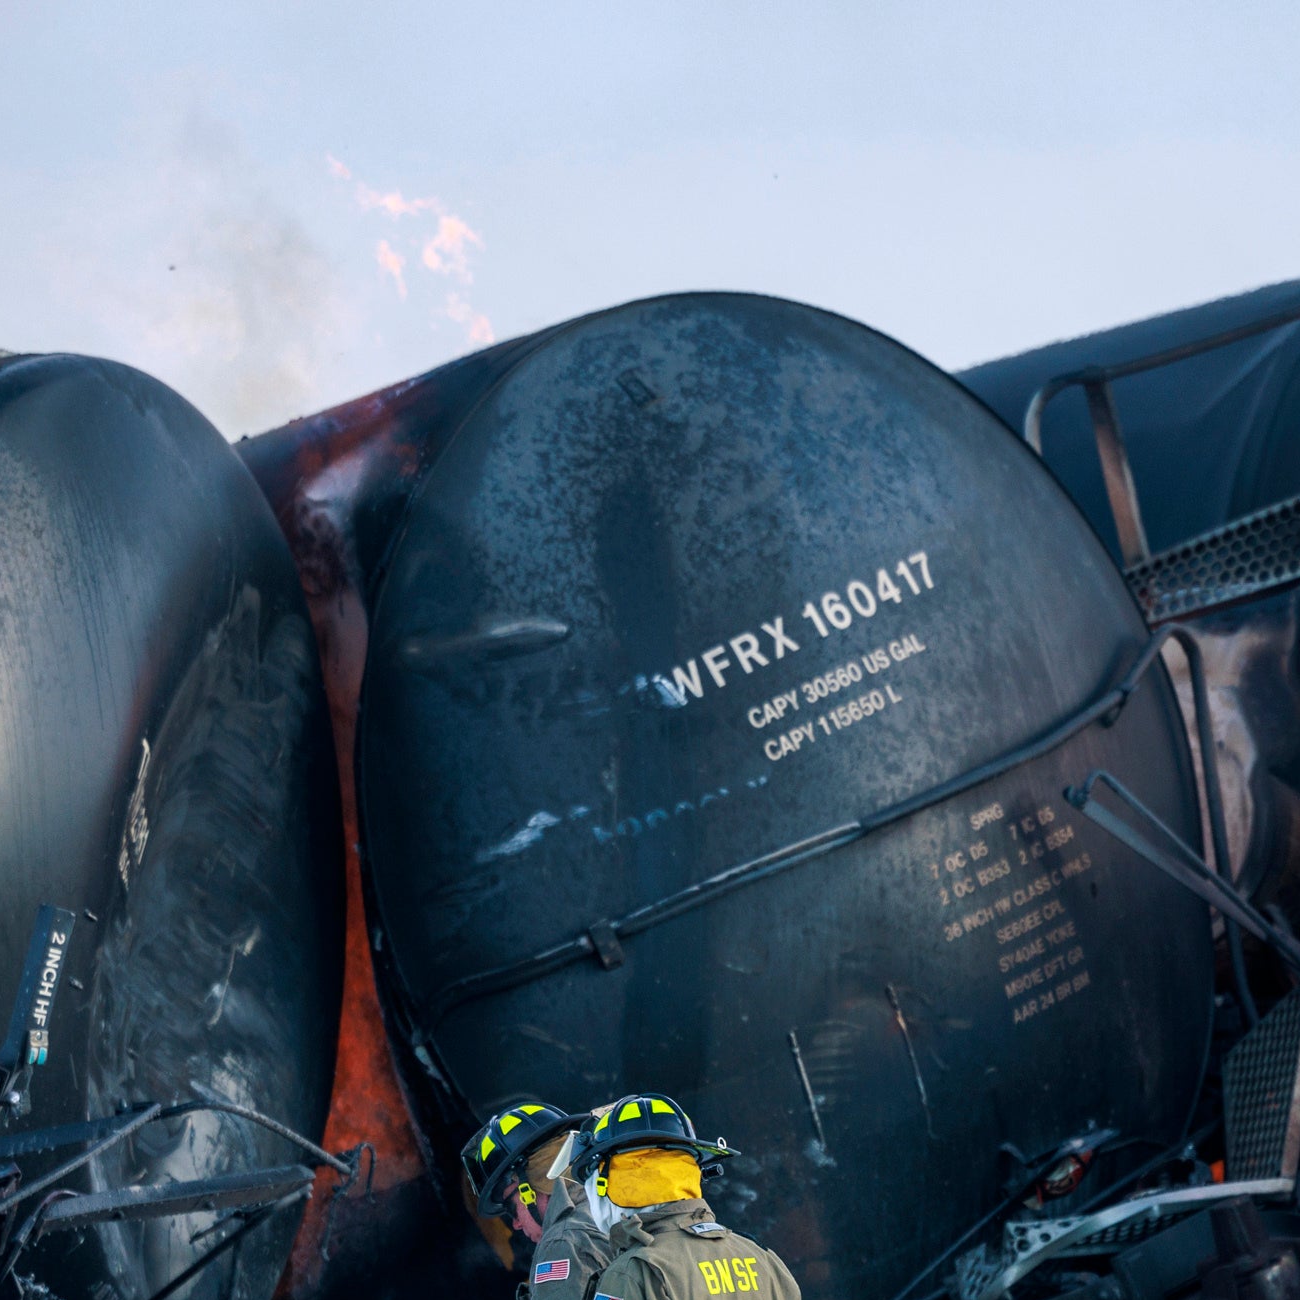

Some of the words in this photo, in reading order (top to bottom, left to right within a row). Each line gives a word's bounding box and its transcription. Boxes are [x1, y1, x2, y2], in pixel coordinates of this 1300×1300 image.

[660, 616, 800, 706] WFRX
[802, 551, 935, 638] 160417
[748, 690, 800, 729] CAPY
[802, 663, 863, 704] 30560
[861, 649, 891, 674] US
[890, 633, 927, 662] GAL
[764, 721, 816, 761] CAPY
[818, 690, 886, 736] 115650
[885, 684, 903, 705] L
[52, 932, 66, 945] 2
[38, 948, 63, 998] INCH
[33, 999, 50, 1027] HF
[698, 1257, 759, 1295] BNSF
